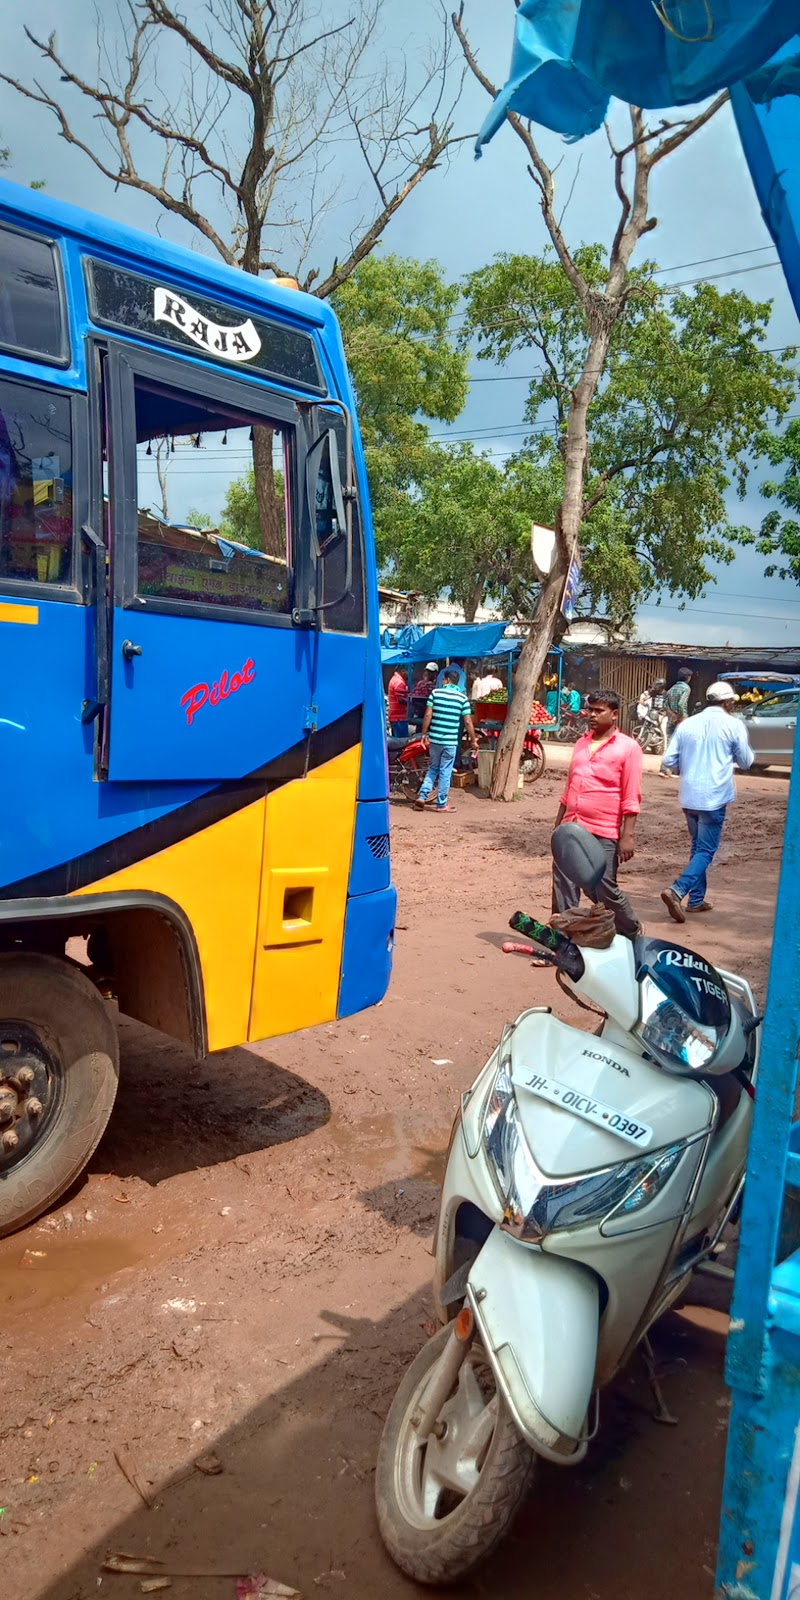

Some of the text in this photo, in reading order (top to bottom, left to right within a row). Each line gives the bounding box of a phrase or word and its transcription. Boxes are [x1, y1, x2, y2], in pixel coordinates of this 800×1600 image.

[161, 294, 254, 355] RAJA
[180, 657, 256, 726] Pilot
[690, 976, 729, 1006] TIGER
[581, 1049, 631, 1079] HONDA
[608, 1114, 648, 1141] 0397
